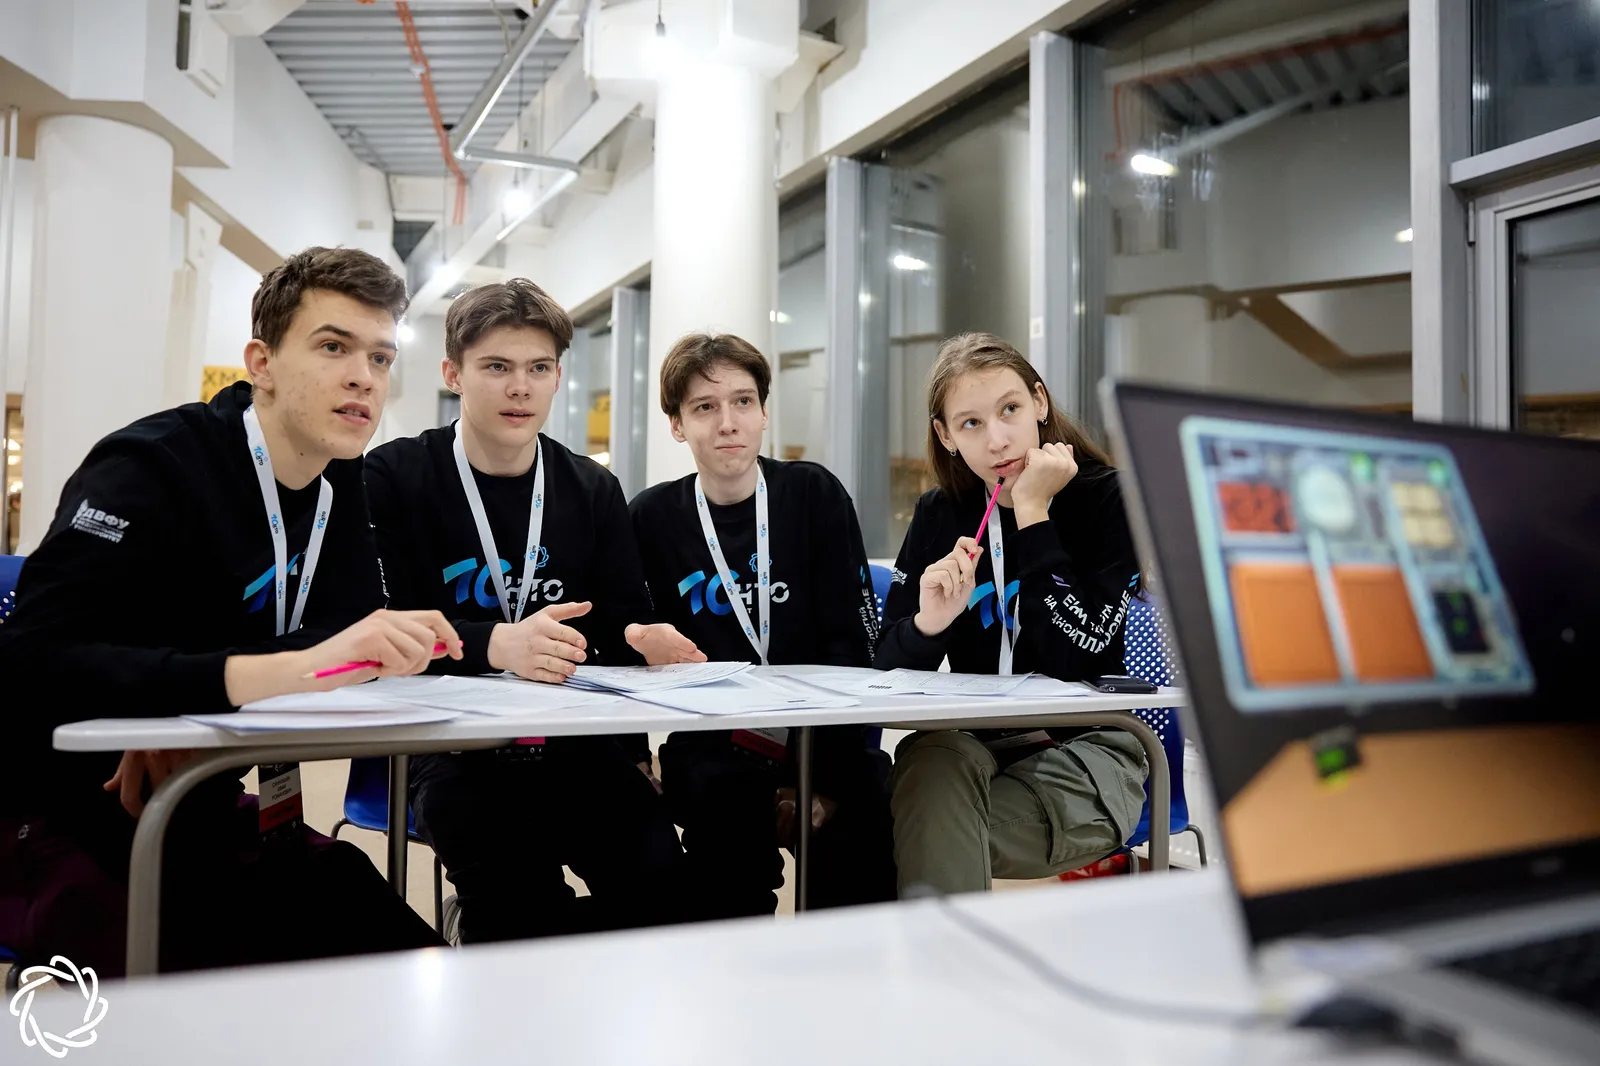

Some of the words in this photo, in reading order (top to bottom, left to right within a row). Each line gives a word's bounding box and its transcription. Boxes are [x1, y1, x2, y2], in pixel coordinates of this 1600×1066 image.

[82, 508, 130, 530] ДВФУ
[442, 557, 513, 610] 10
[677, 569, 740, 616] 10
[1043, 594, 1058, 611] НА
